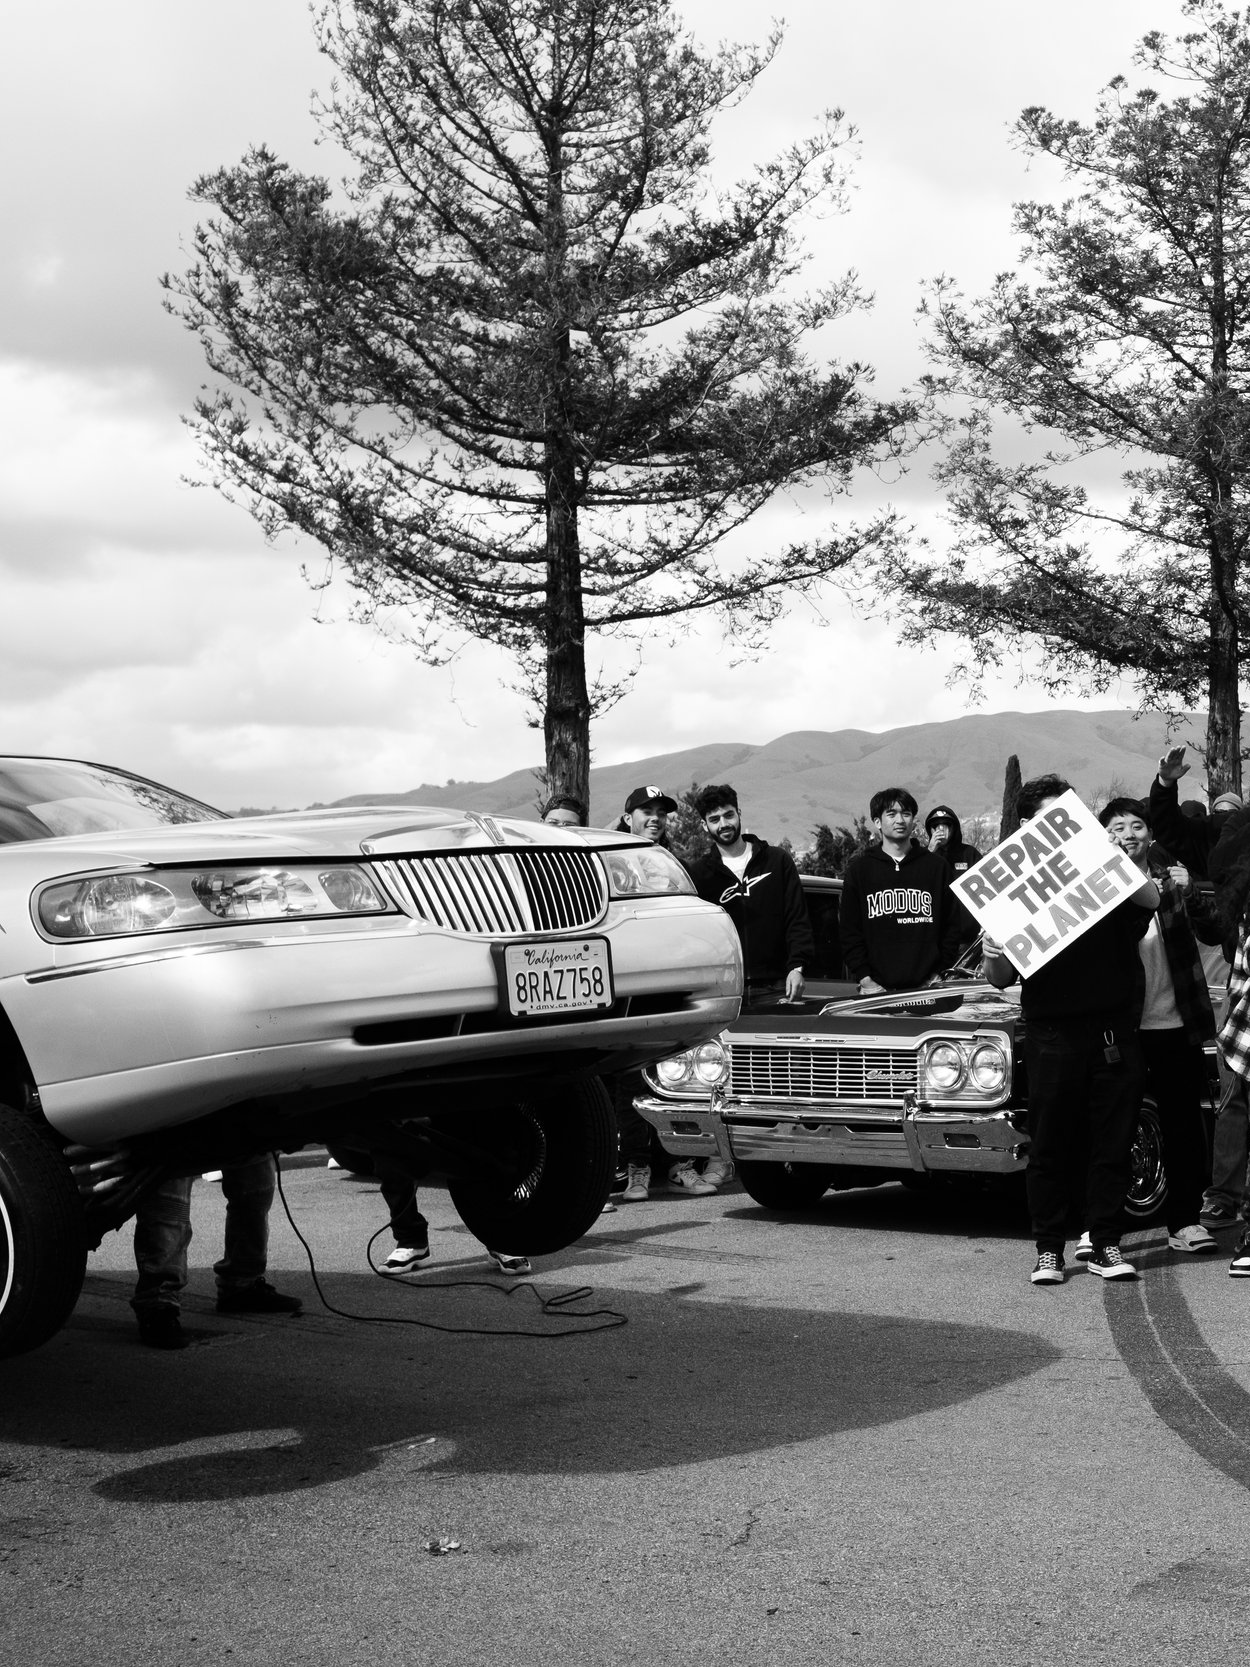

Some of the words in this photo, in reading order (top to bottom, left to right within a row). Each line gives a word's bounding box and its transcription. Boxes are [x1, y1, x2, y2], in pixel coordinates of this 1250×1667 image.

[959, 807, 1083, 910] REPAIR
[1007, 850, 1081, 915] THE
[867, 888, 932, 919] MODUS
[897, 916, 933, 924] WORLDWIDE
[1005, 854, 1133, 969] PLANET
[527, 948, 589, 968] California
[516, 966, 604, 1003] 8RAZ758
[536, 1001, 588, 1010] dmv.ca.gov
